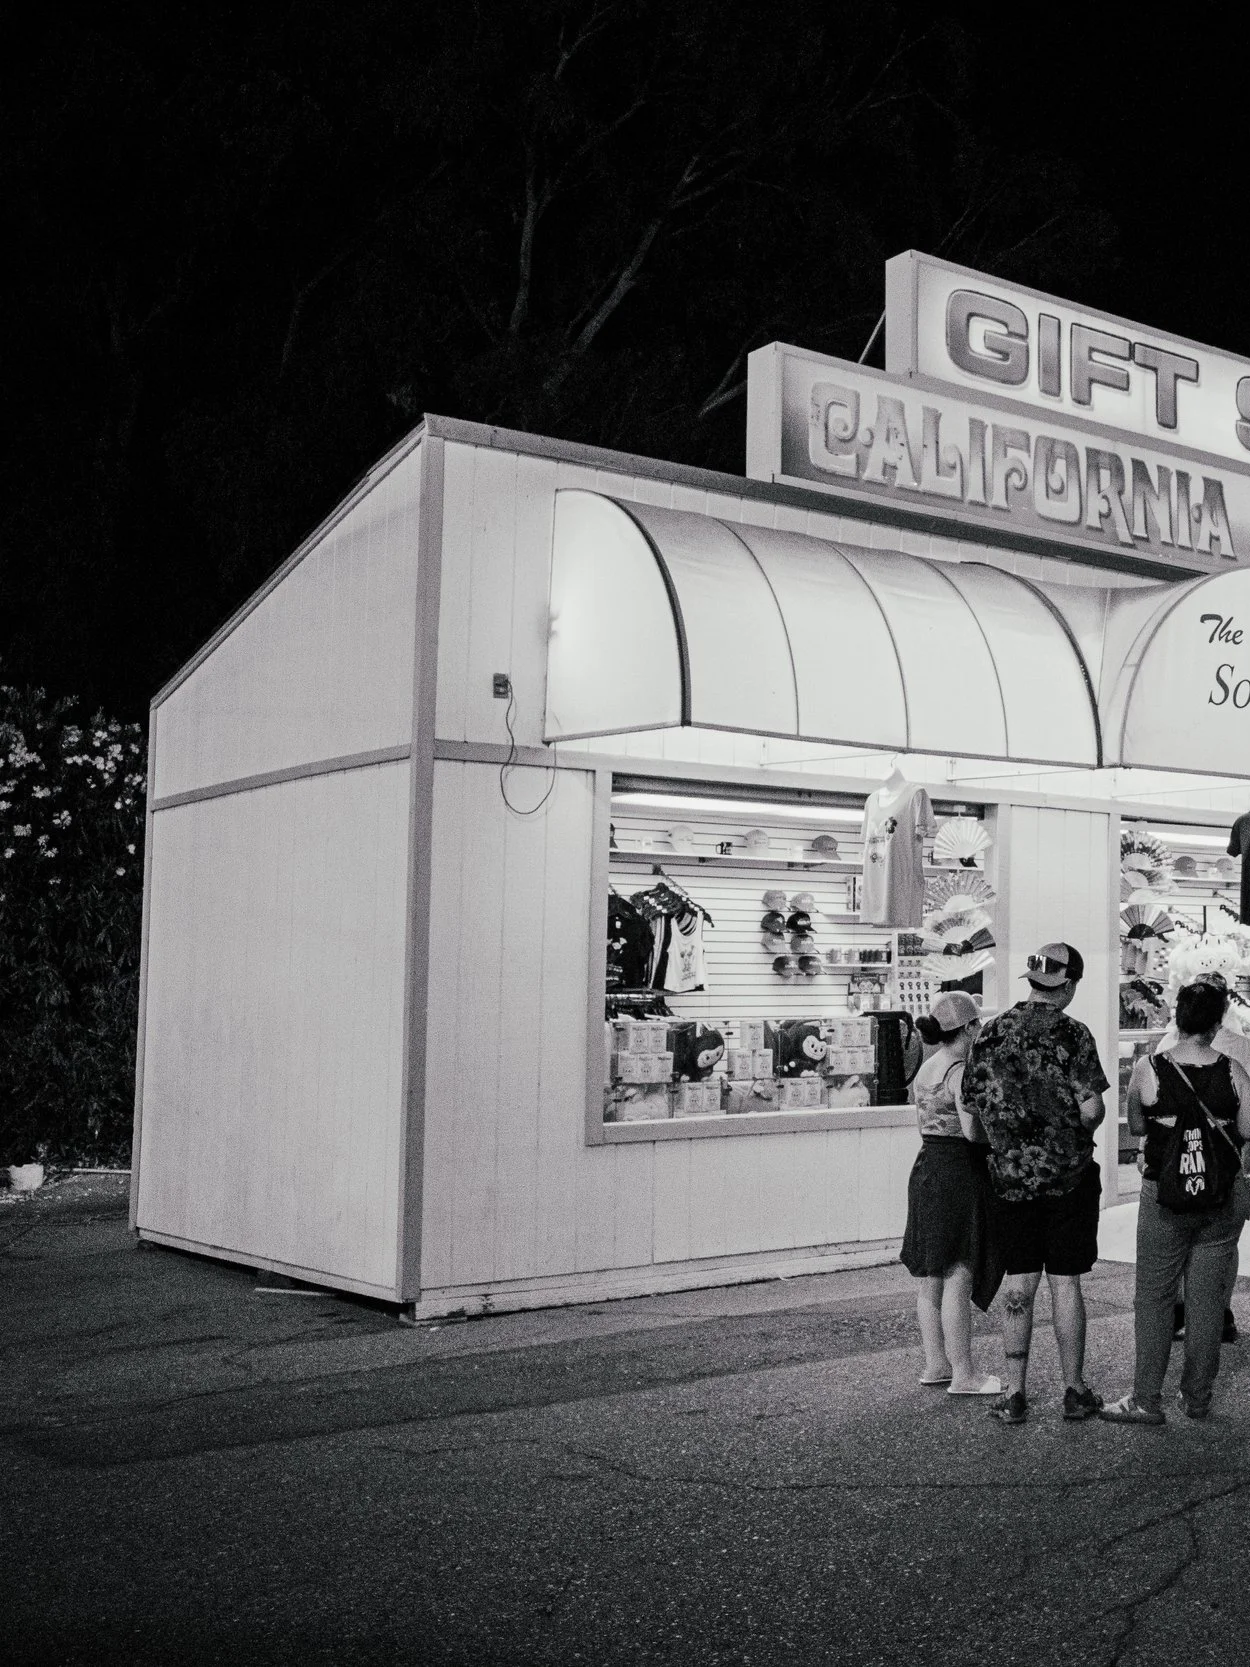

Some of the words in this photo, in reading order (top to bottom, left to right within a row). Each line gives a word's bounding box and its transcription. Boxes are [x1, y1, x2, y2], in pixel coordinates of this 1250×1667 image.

[945, 287, 1200, 432] GIFT
[809, 380, 1236, 560] CALIFORNIA
[1200, 613, 1244, 645] The
